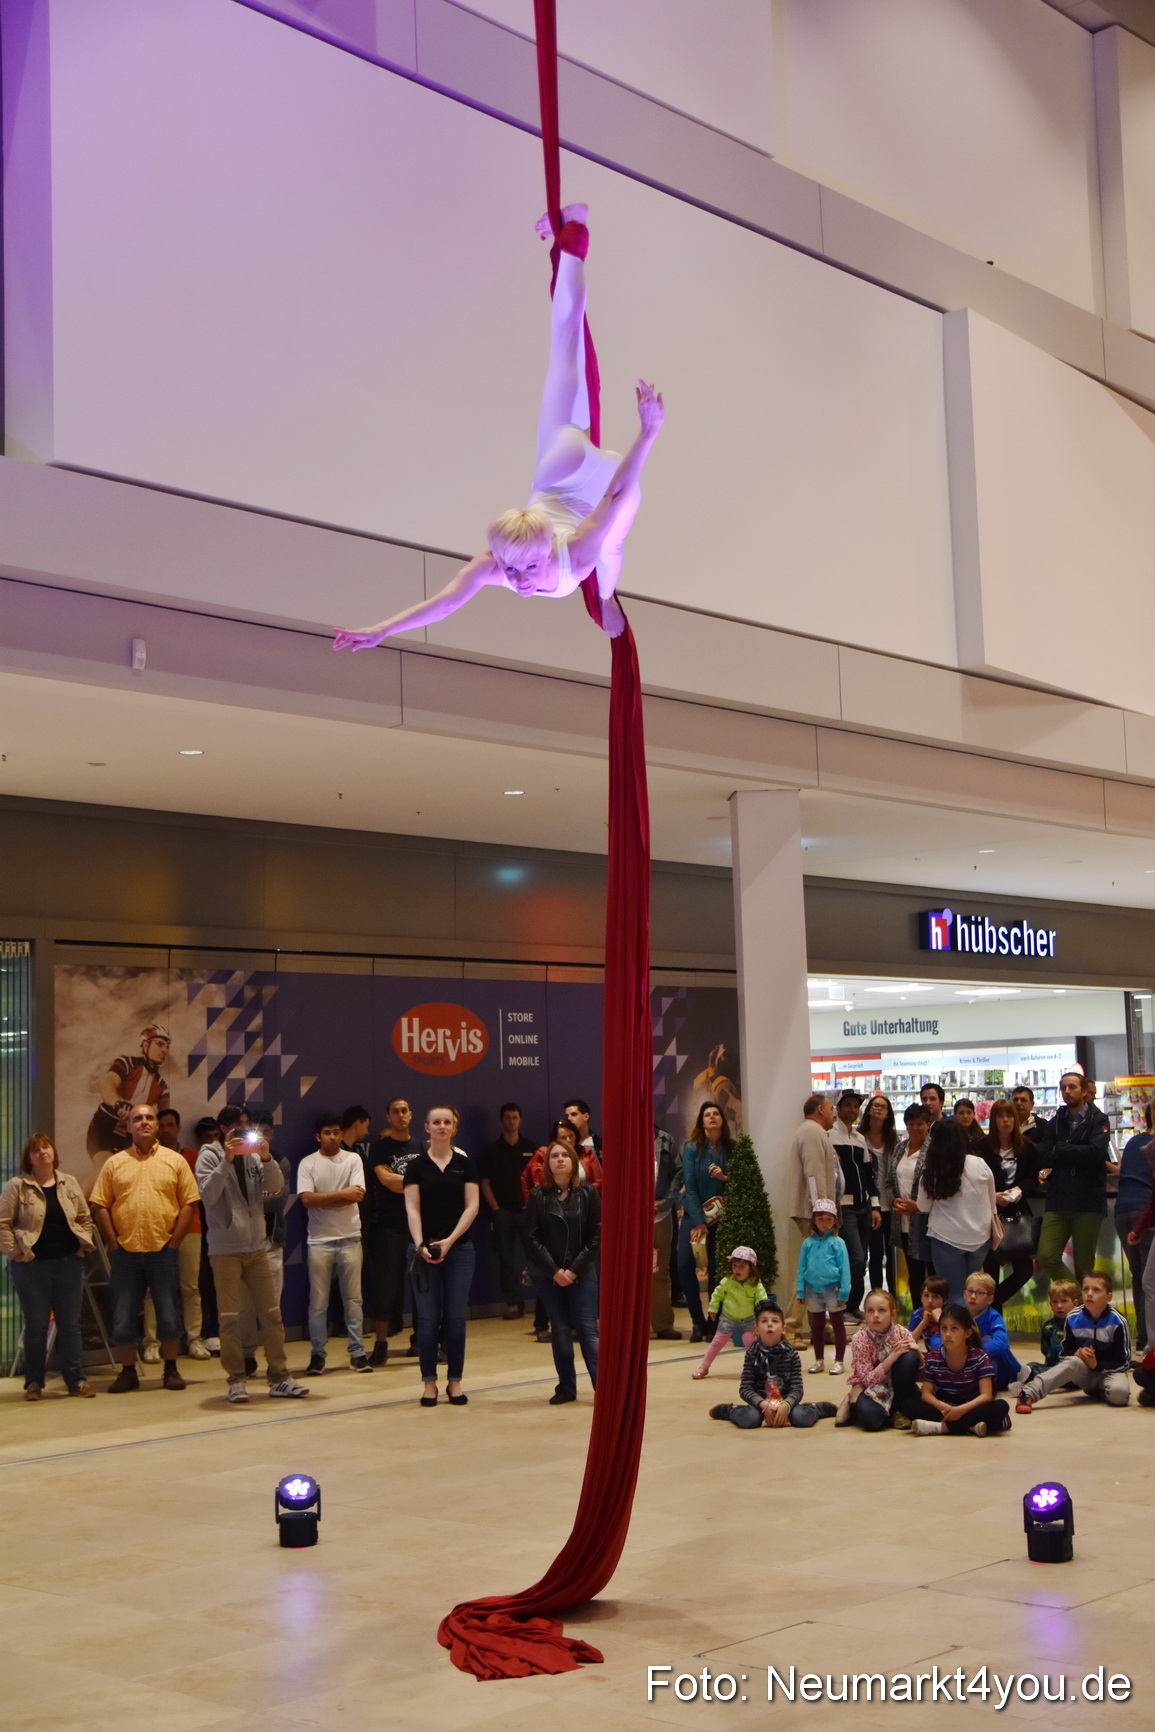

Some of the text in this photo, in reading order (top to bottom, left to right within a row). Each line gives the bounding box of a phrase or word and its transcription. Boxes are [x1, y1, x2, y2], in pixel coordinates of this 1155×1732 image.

[957, 914, 1056, 957] hübscher
[508, 1012, 533, 1022] STORE
[843, 1017, 939, 1036] Gute Unterhaltung
[401, 1017, 484, 1062] Hervis
[508, 1034, 539, 1044] ONLINE
[509, 1057, 540, 1066] MOBILE
[848, 1062, 864, 1070] Gespräch
[899, 1060, 917, 1068] Spannung
